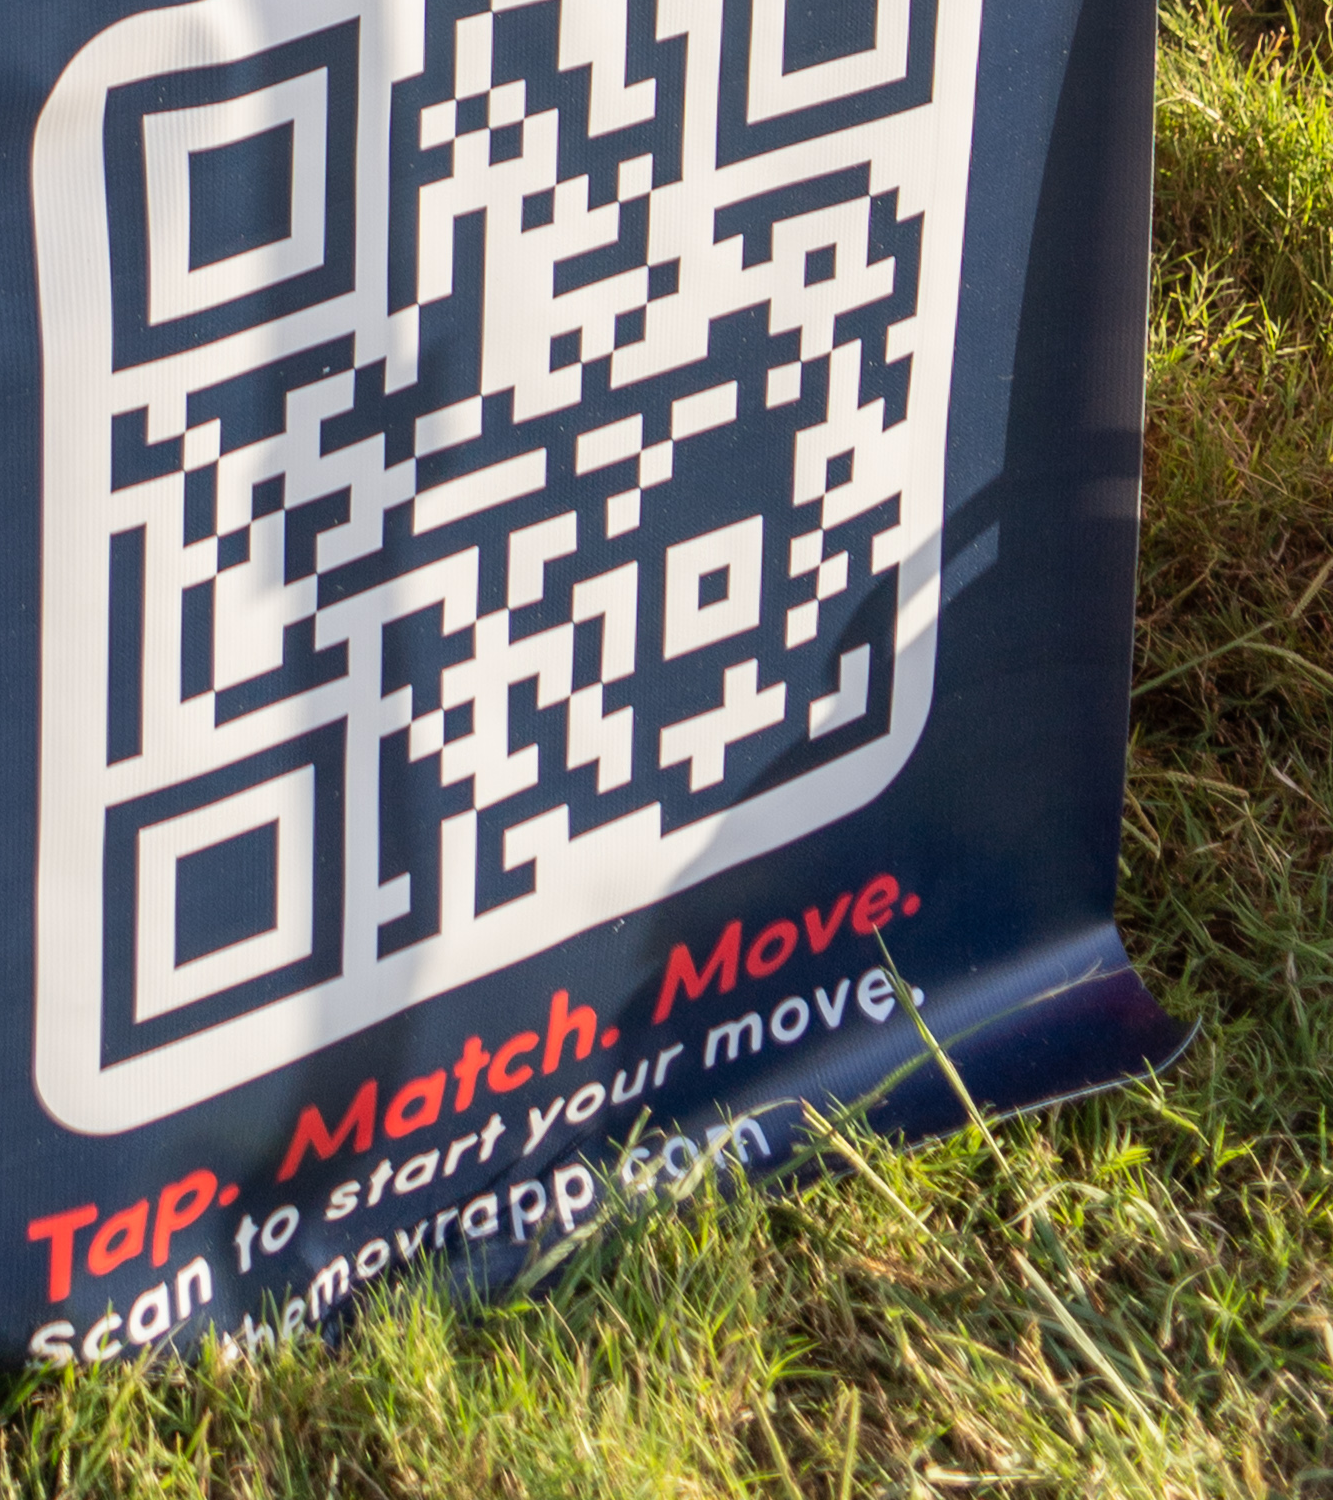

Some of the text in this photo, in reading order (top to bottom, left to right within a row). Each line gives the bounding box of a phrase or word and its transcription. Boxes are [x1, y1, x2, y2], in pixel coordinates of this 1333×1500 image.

[26, 871, 921, 1303] Tap. Match. Move.
[27, 964, 926, 1370] scan to start your move.
